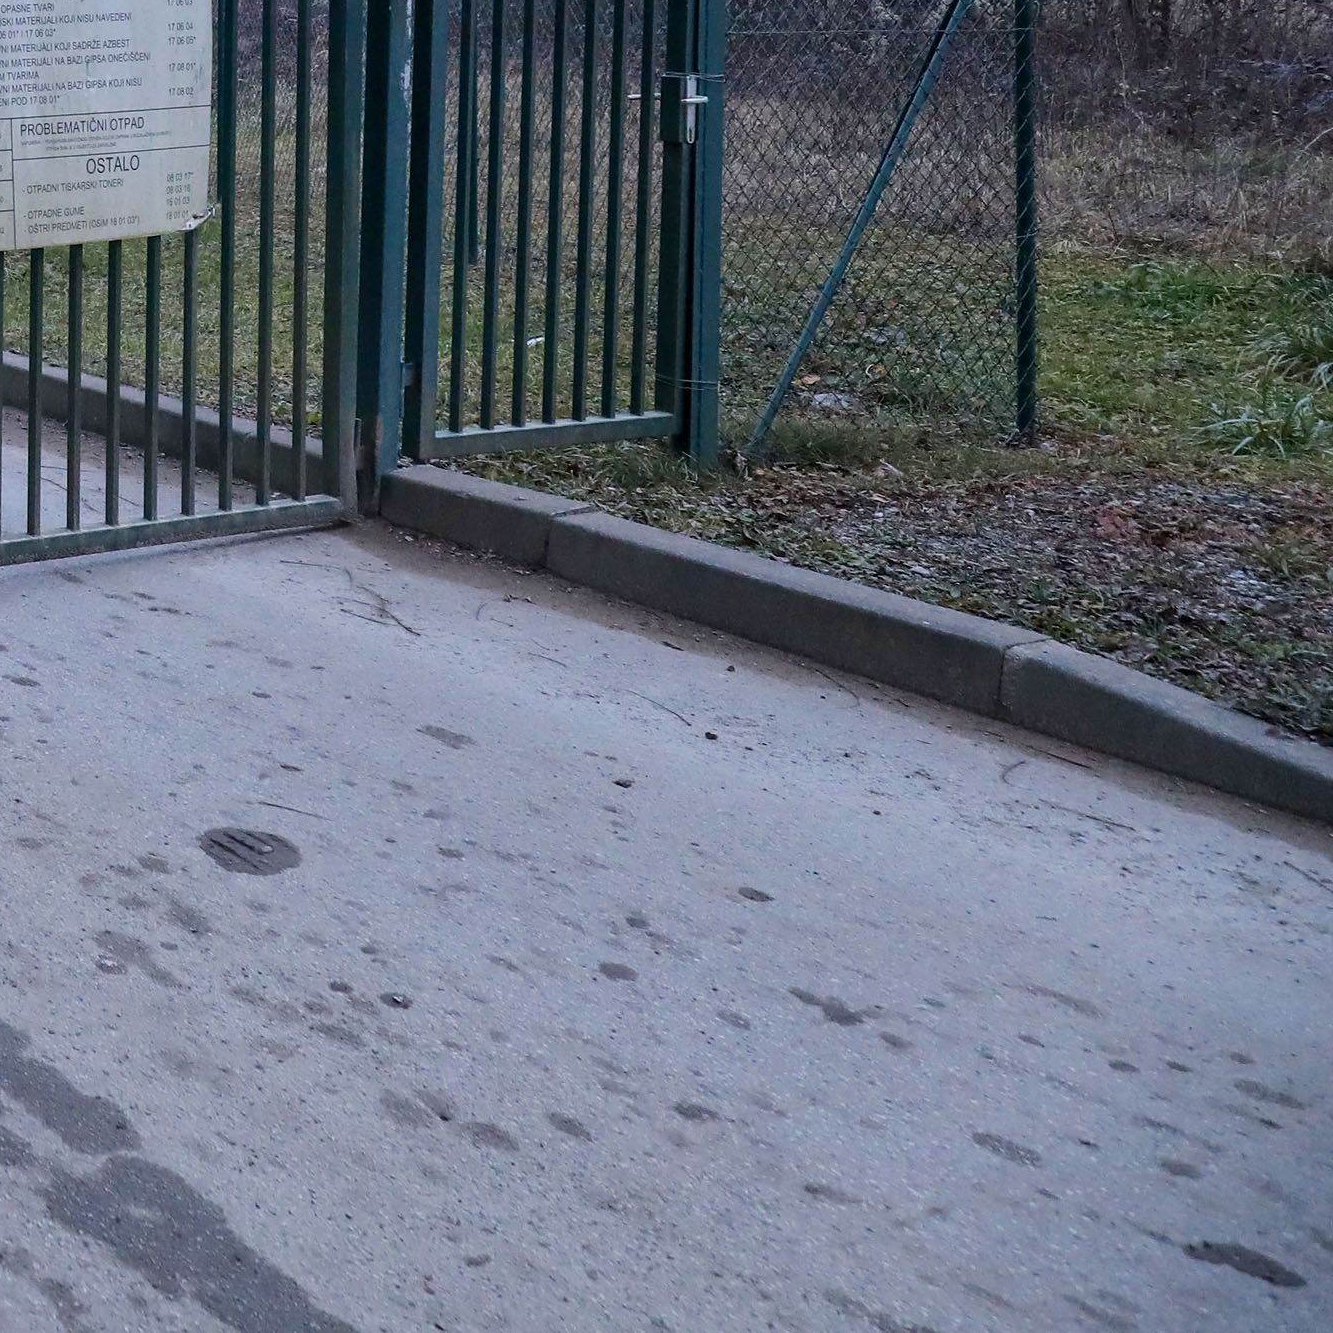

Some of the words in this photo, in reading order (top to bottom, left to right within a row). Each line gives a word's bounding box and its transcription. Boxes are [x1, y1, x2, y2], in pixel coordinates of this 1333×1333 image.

[21, 117, 107, 136] PROBLEMATIČNI
[110, 117, 144, 130] OTPAD
[86, 155, 139, 174] OSTALO
